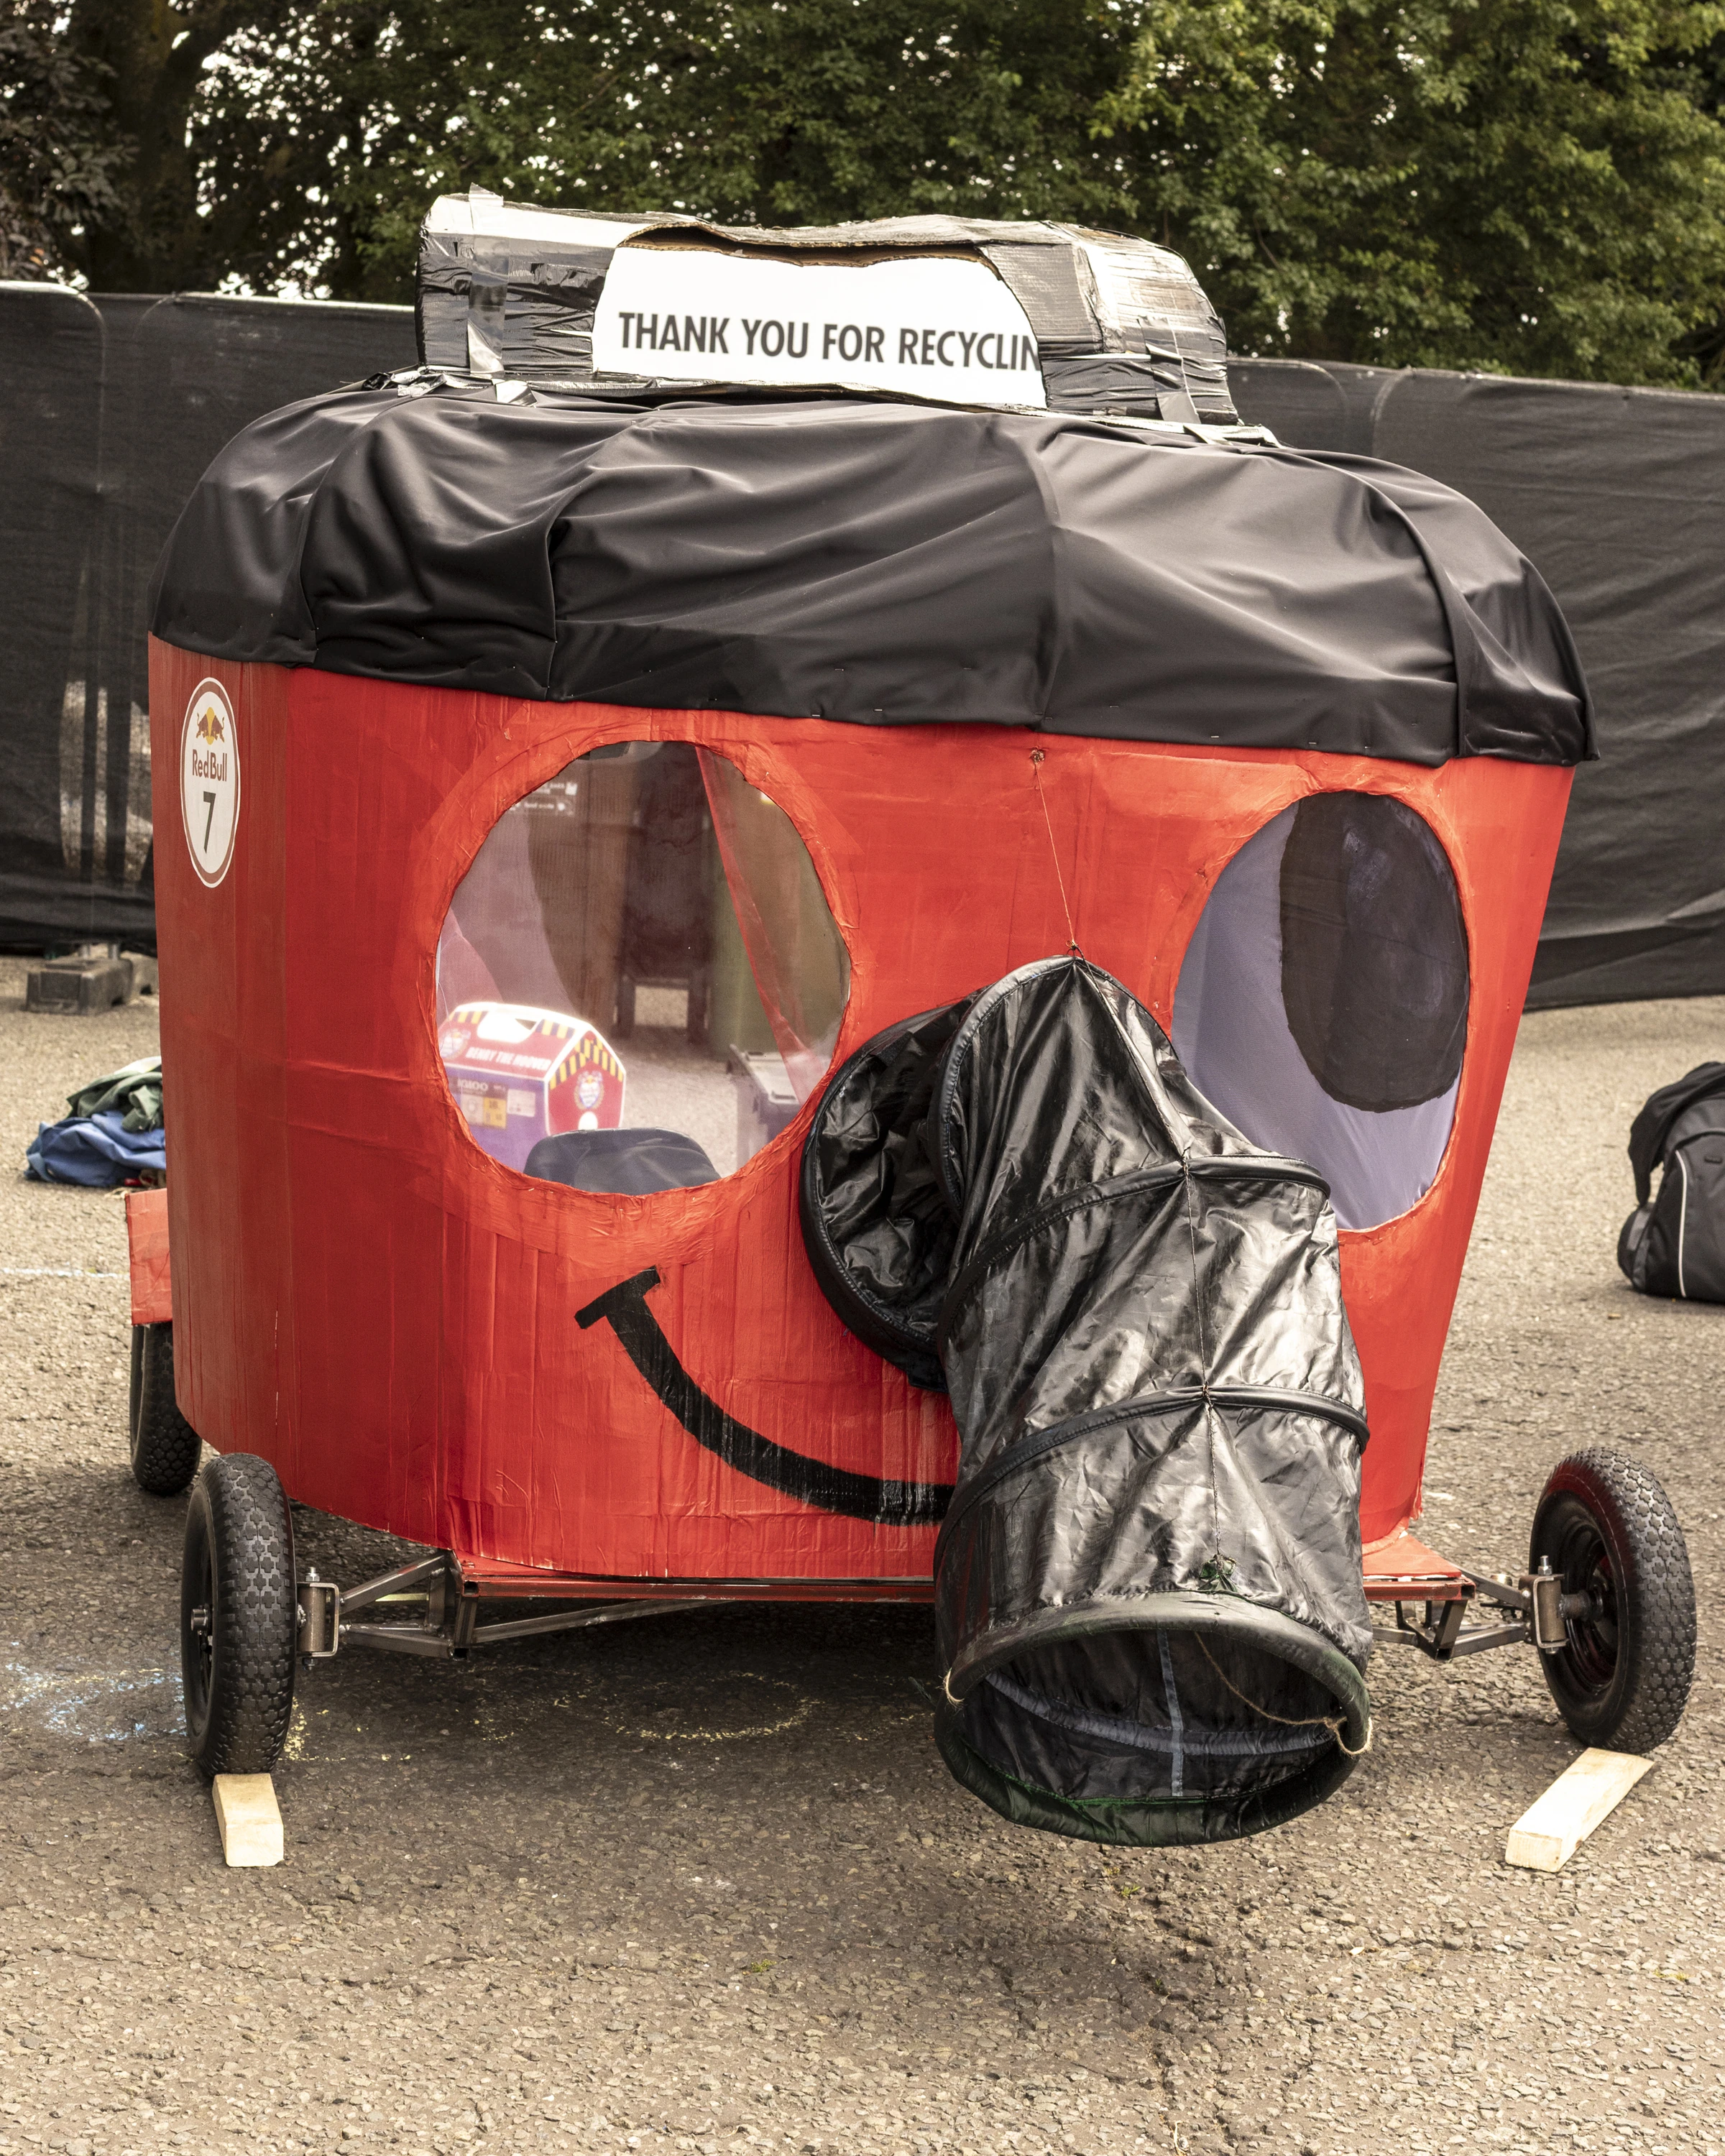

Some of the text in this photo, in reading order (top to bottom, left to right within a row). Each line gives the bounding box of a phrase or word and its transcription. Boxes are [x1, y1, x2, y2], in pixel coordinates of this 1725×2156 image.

[619, 311, 730, 354] THANK
[741, 318, 809, 359] YOU
[823, 323, 885, 364] FOR
[192, 749, 227, 782] Red Bull
[203, 791, 216, 854] 7
